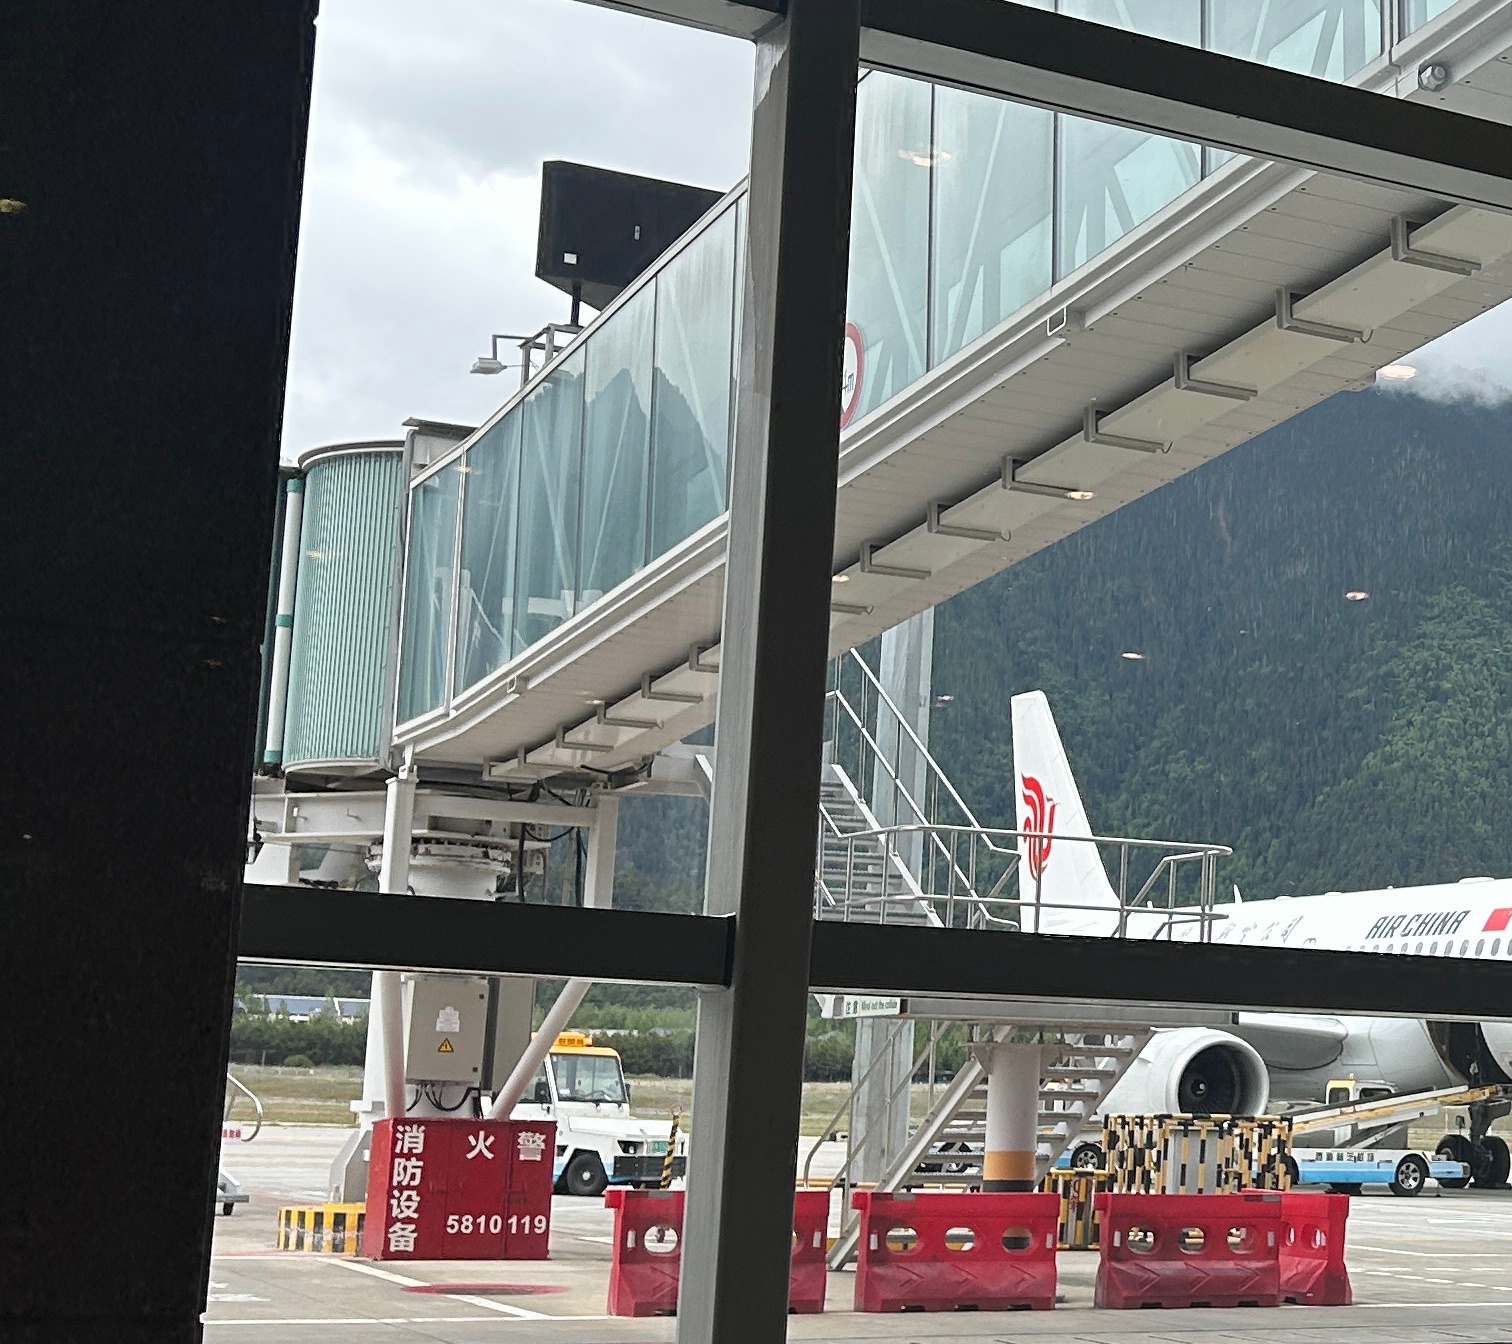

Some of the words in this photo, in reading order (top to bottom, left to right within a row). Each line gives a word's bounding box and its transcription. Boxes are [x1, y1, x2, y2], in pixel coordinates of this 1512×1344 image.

[1365, 914, 1405, 940] AIR
[1401, 909, 1471, 938] CHINA
[387, 1124, 426, 1253] 消防设备
